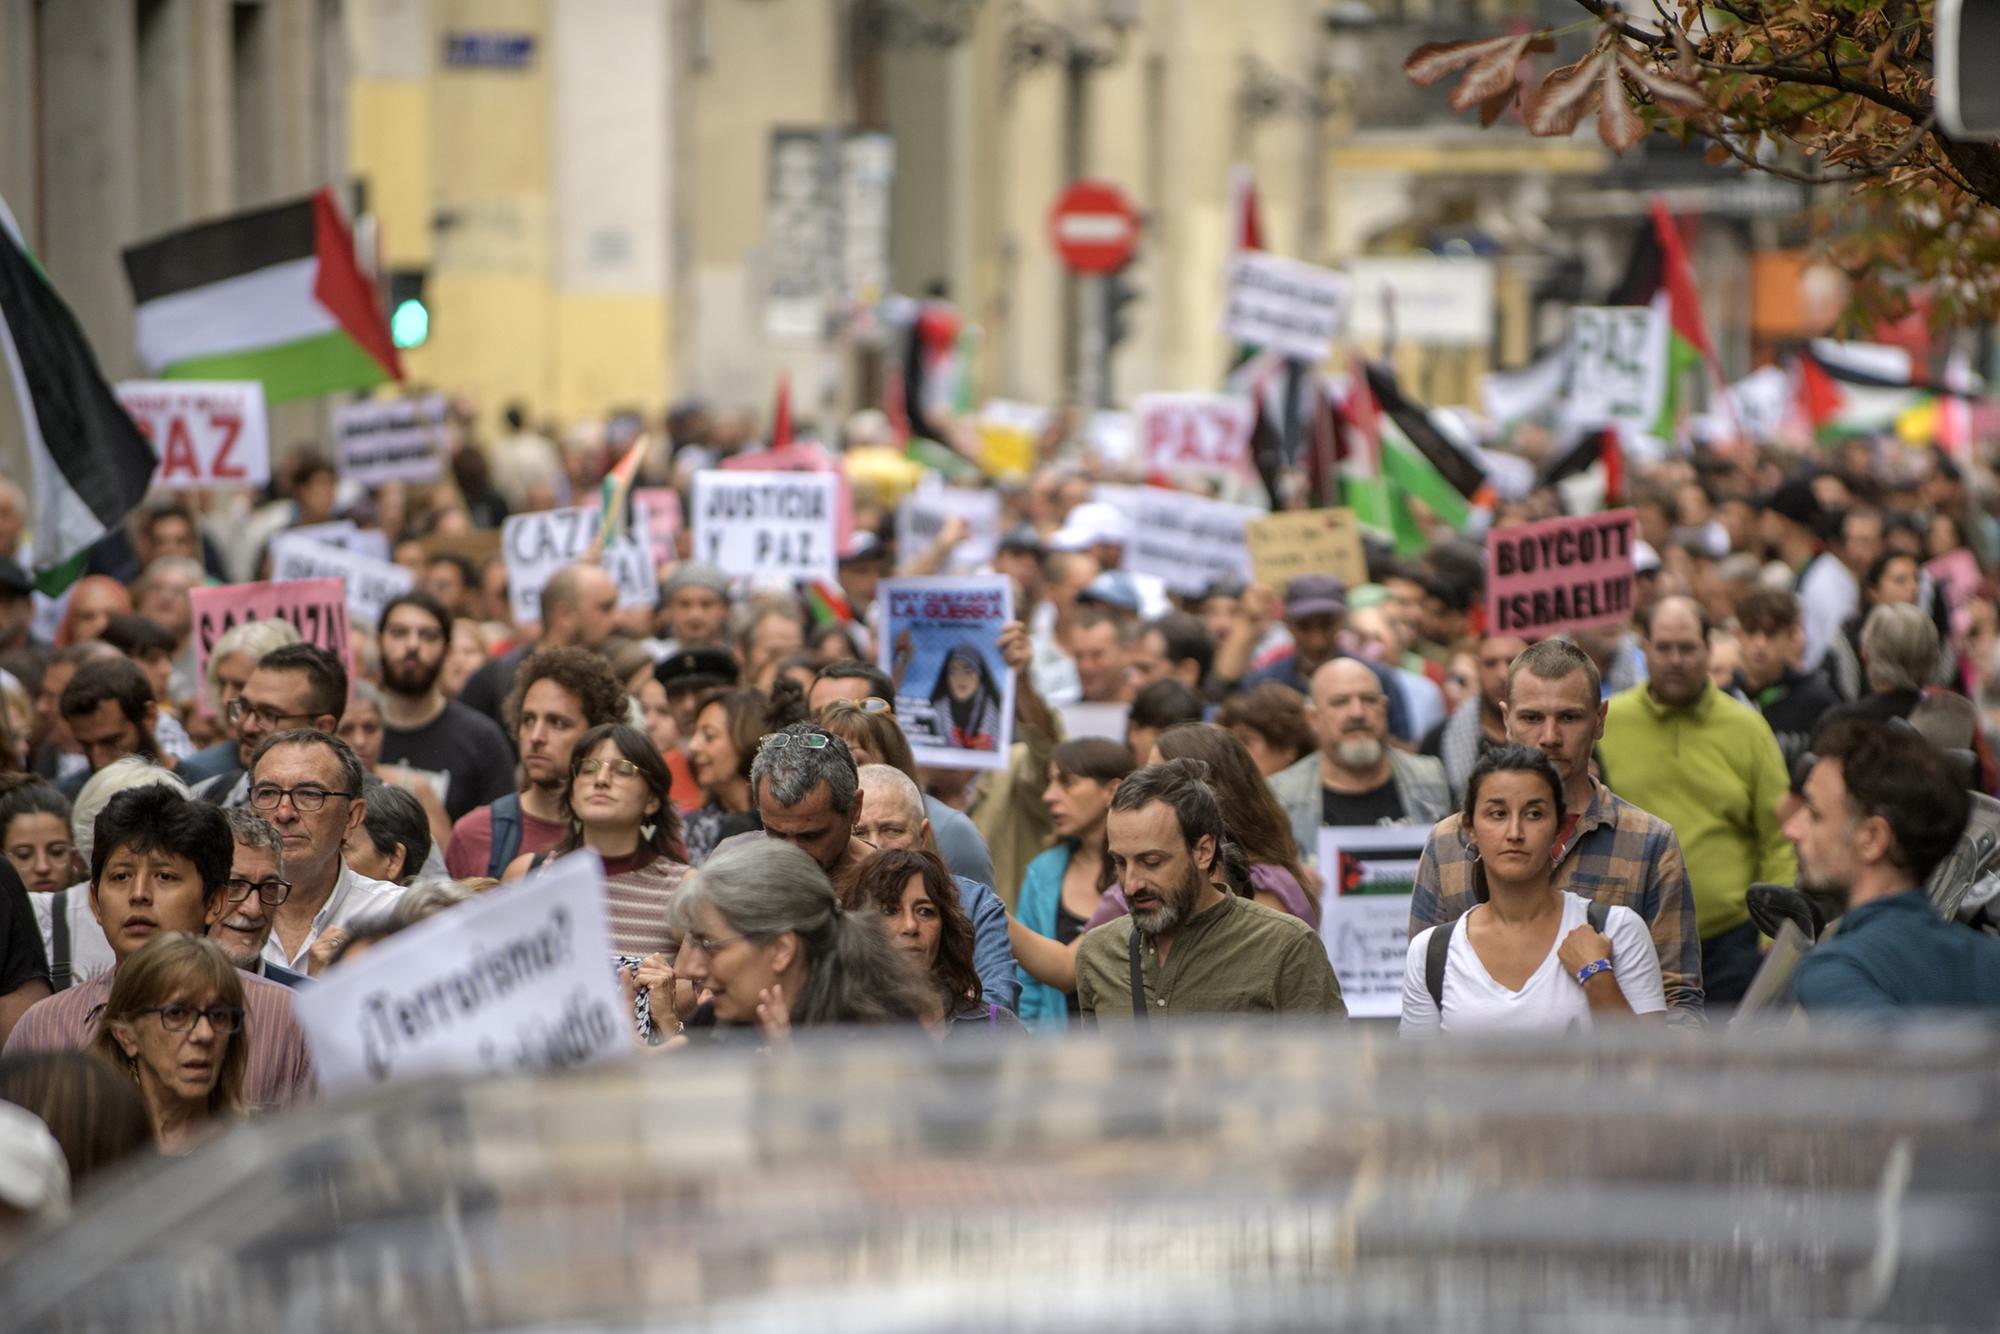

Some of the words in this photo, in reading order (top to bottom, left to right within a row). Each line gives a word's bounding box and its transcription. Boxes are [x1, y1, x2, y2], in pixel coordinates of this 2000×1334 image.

[708, 485, 826, 519] JUSTICIA
[1497, 521, 1631, 577] BOYCOTT
[923, 602, 1002, 620] GUERRA
[1497, 577, 1632, 632] ISRAEL!!!
